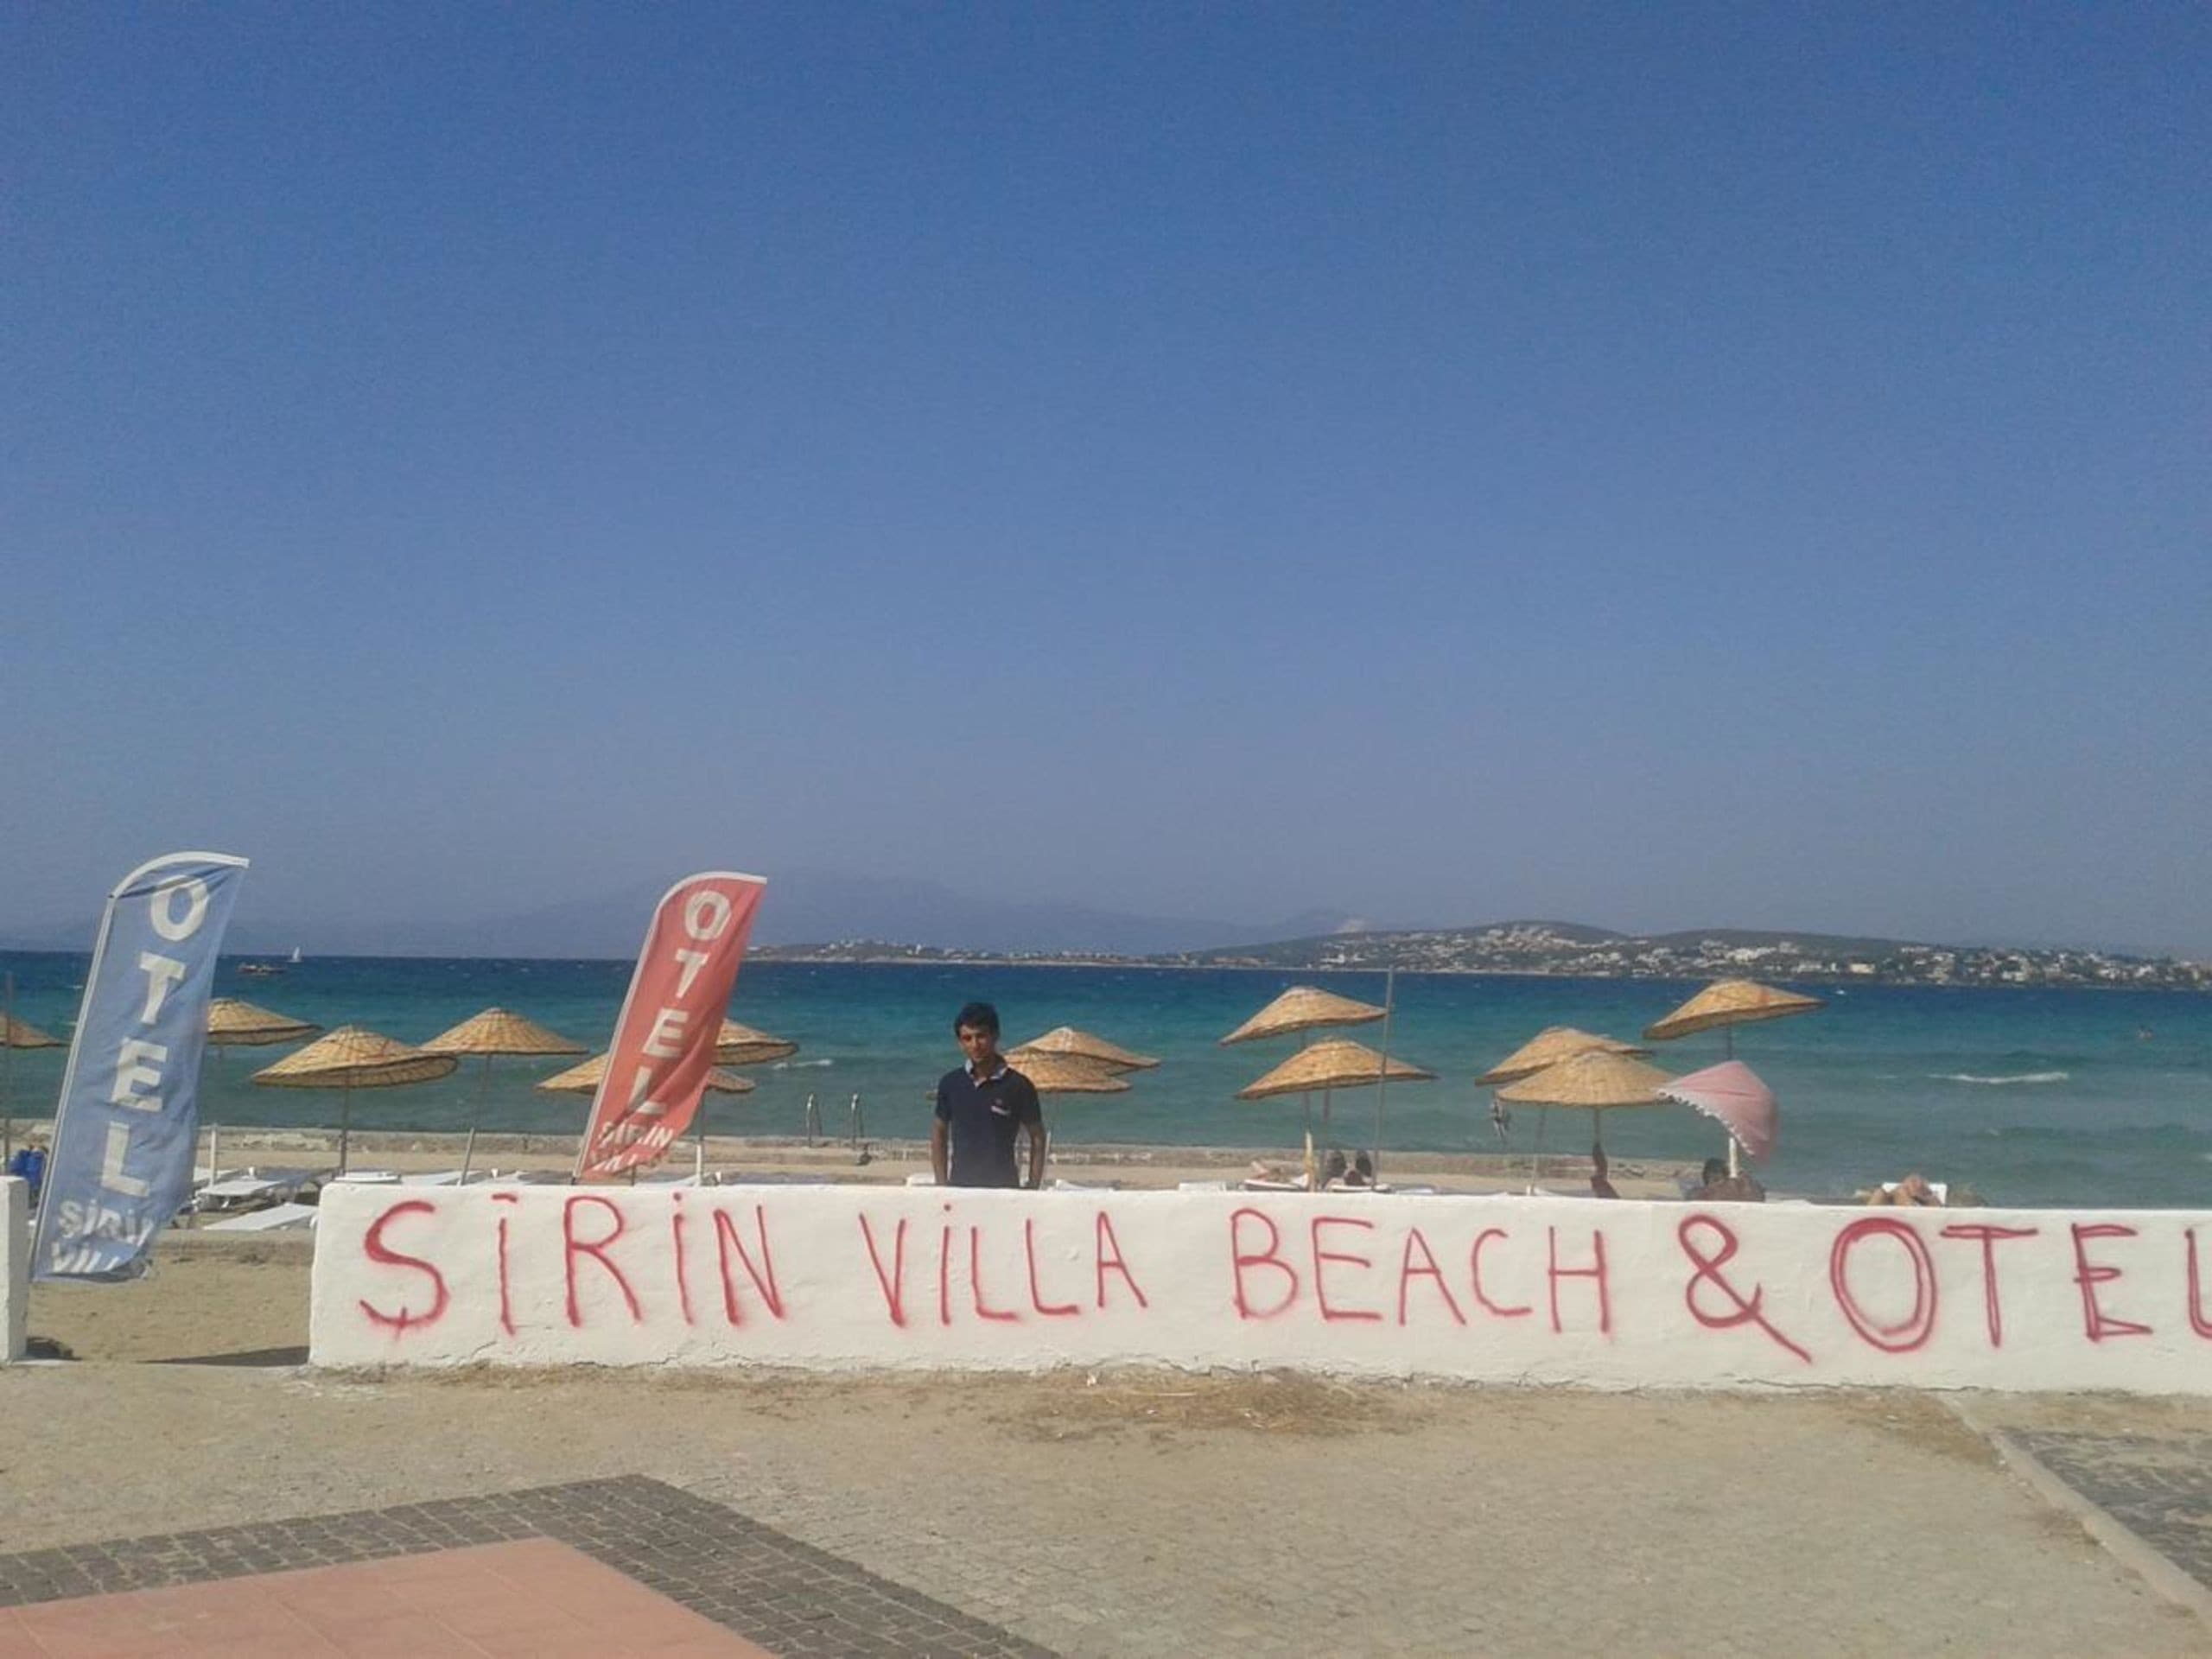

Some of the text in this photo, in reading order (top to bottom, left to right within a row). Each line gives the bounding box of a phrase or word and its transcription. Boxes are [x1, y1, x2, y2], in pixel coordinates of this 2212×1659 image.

[100, 874, 209, 1198] OTEL
[628, 890, 733, 1115] OTEL
[1230, 1207, 1613, 1333] BEACH
[1678, 1214, 1811, 1363] &
[1830, 1217, 2212, 1354] OTEL
